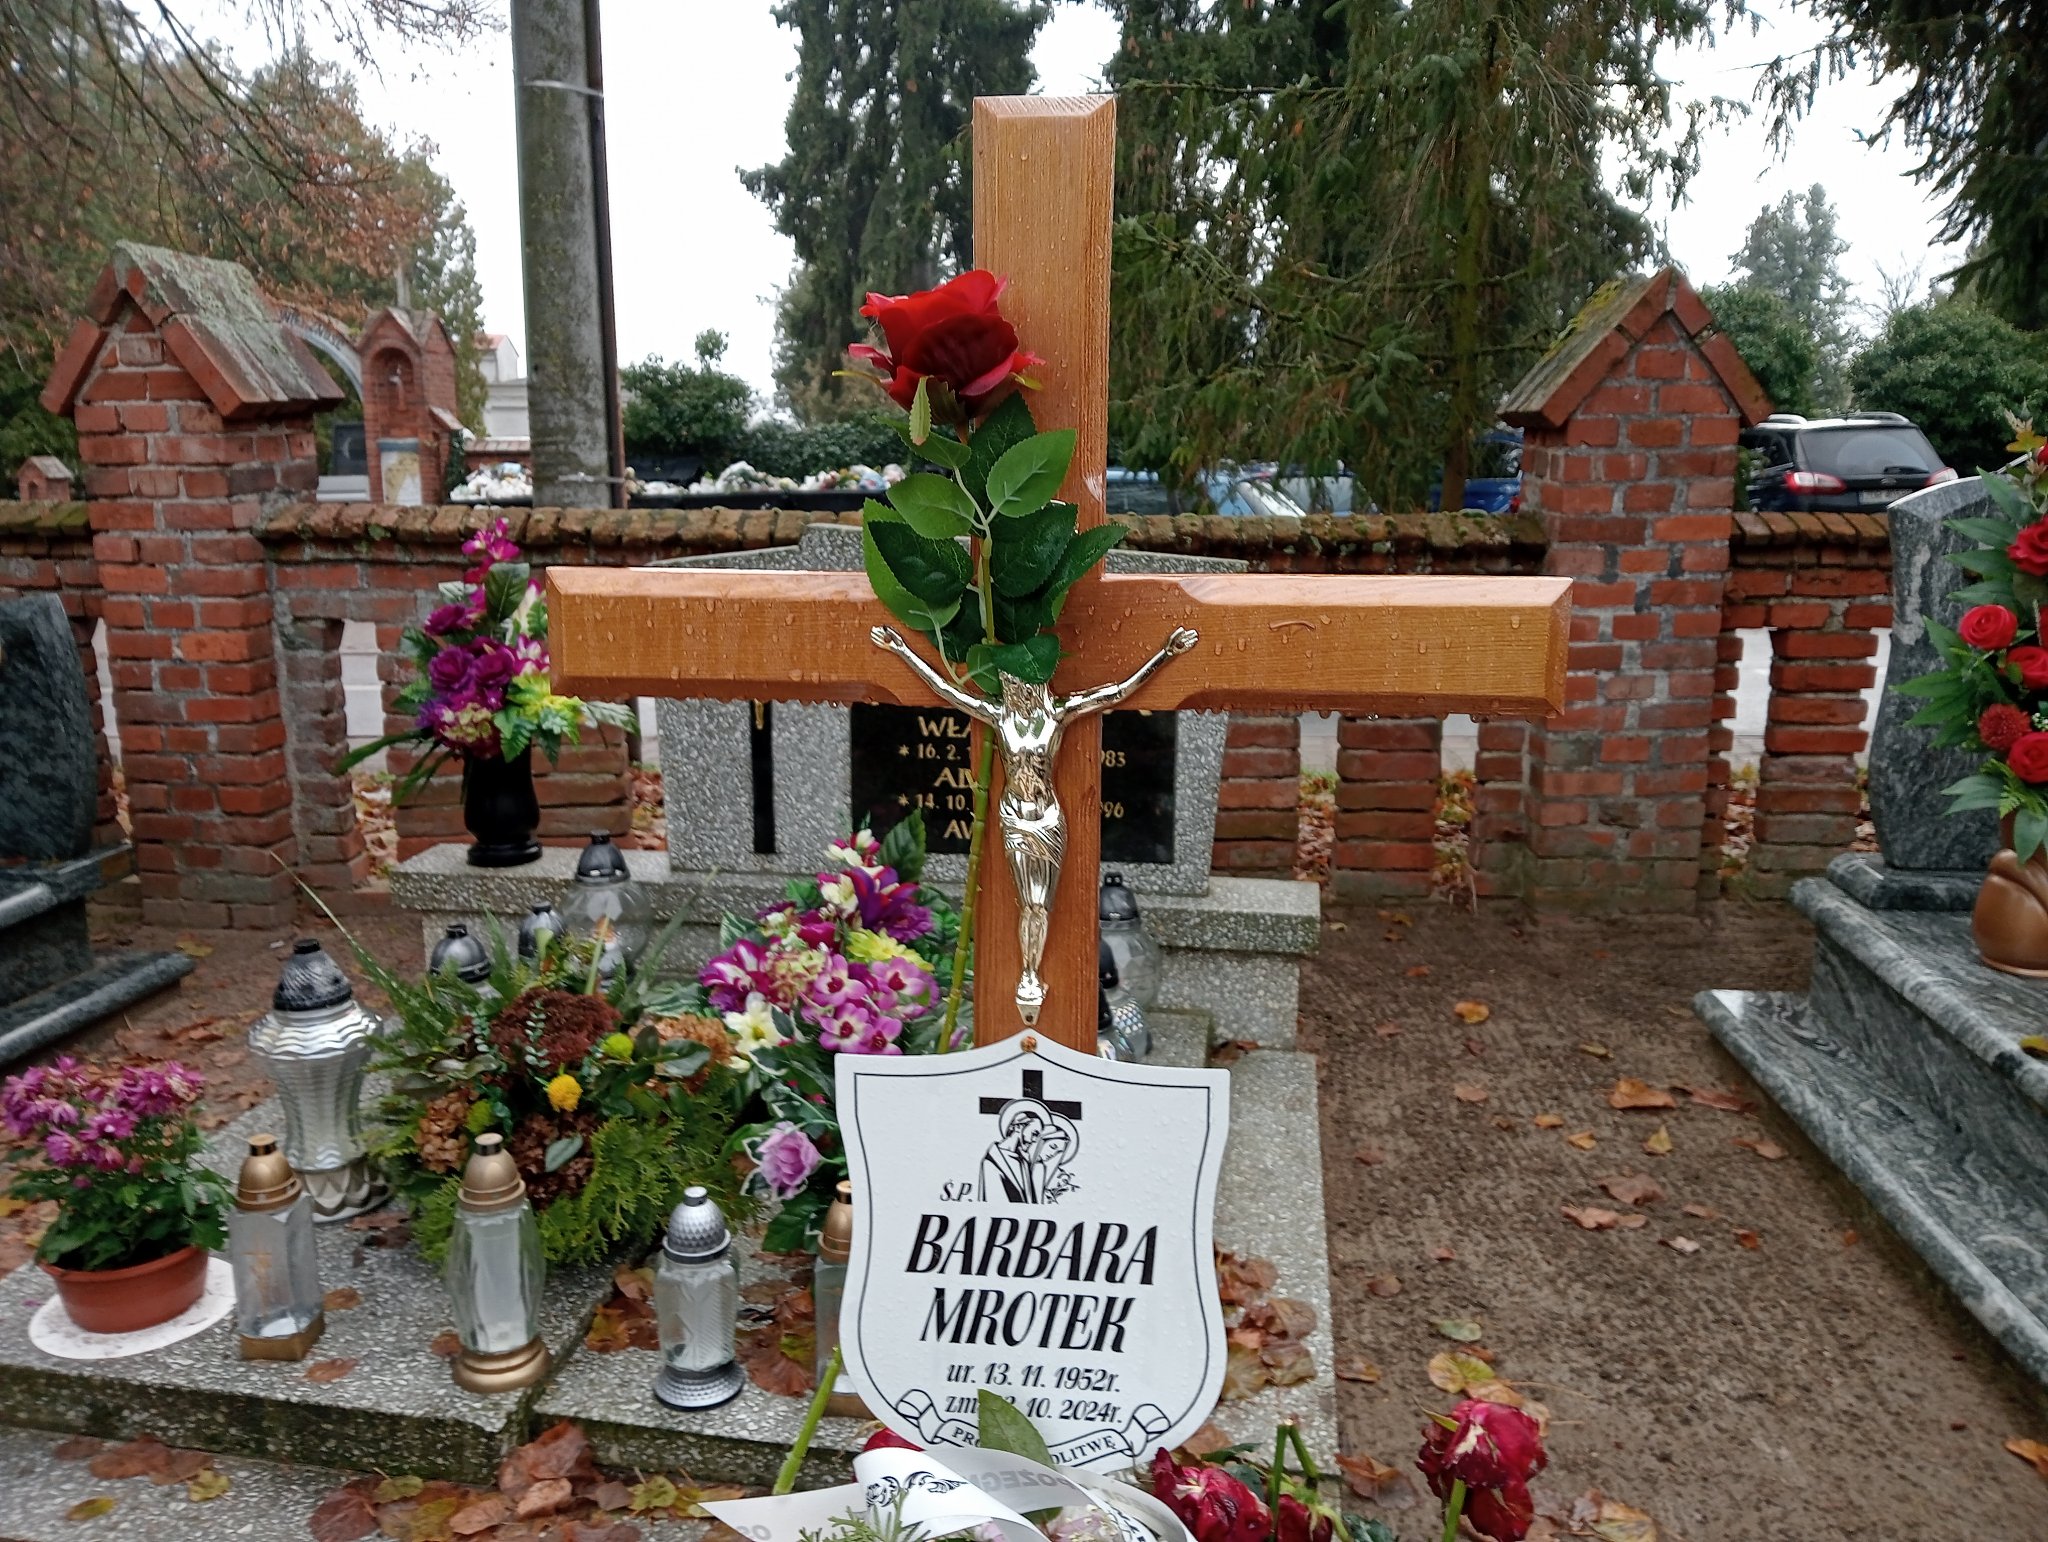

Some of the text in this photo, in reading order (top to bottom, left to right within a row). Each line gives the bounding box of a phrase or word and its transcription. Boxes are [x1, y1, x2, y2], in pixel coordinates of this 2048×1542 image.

[905, 1213, 1158, 1286] BARBARA
[919, 1286, 1136, 1353] MROTEK
[946, 1362, 1121, 1393] ur. 13. 11. 1952r.
[1027, 1397, 1053, 1419] 10.
[1058, 1399, 1123, 1424] 2024r.
